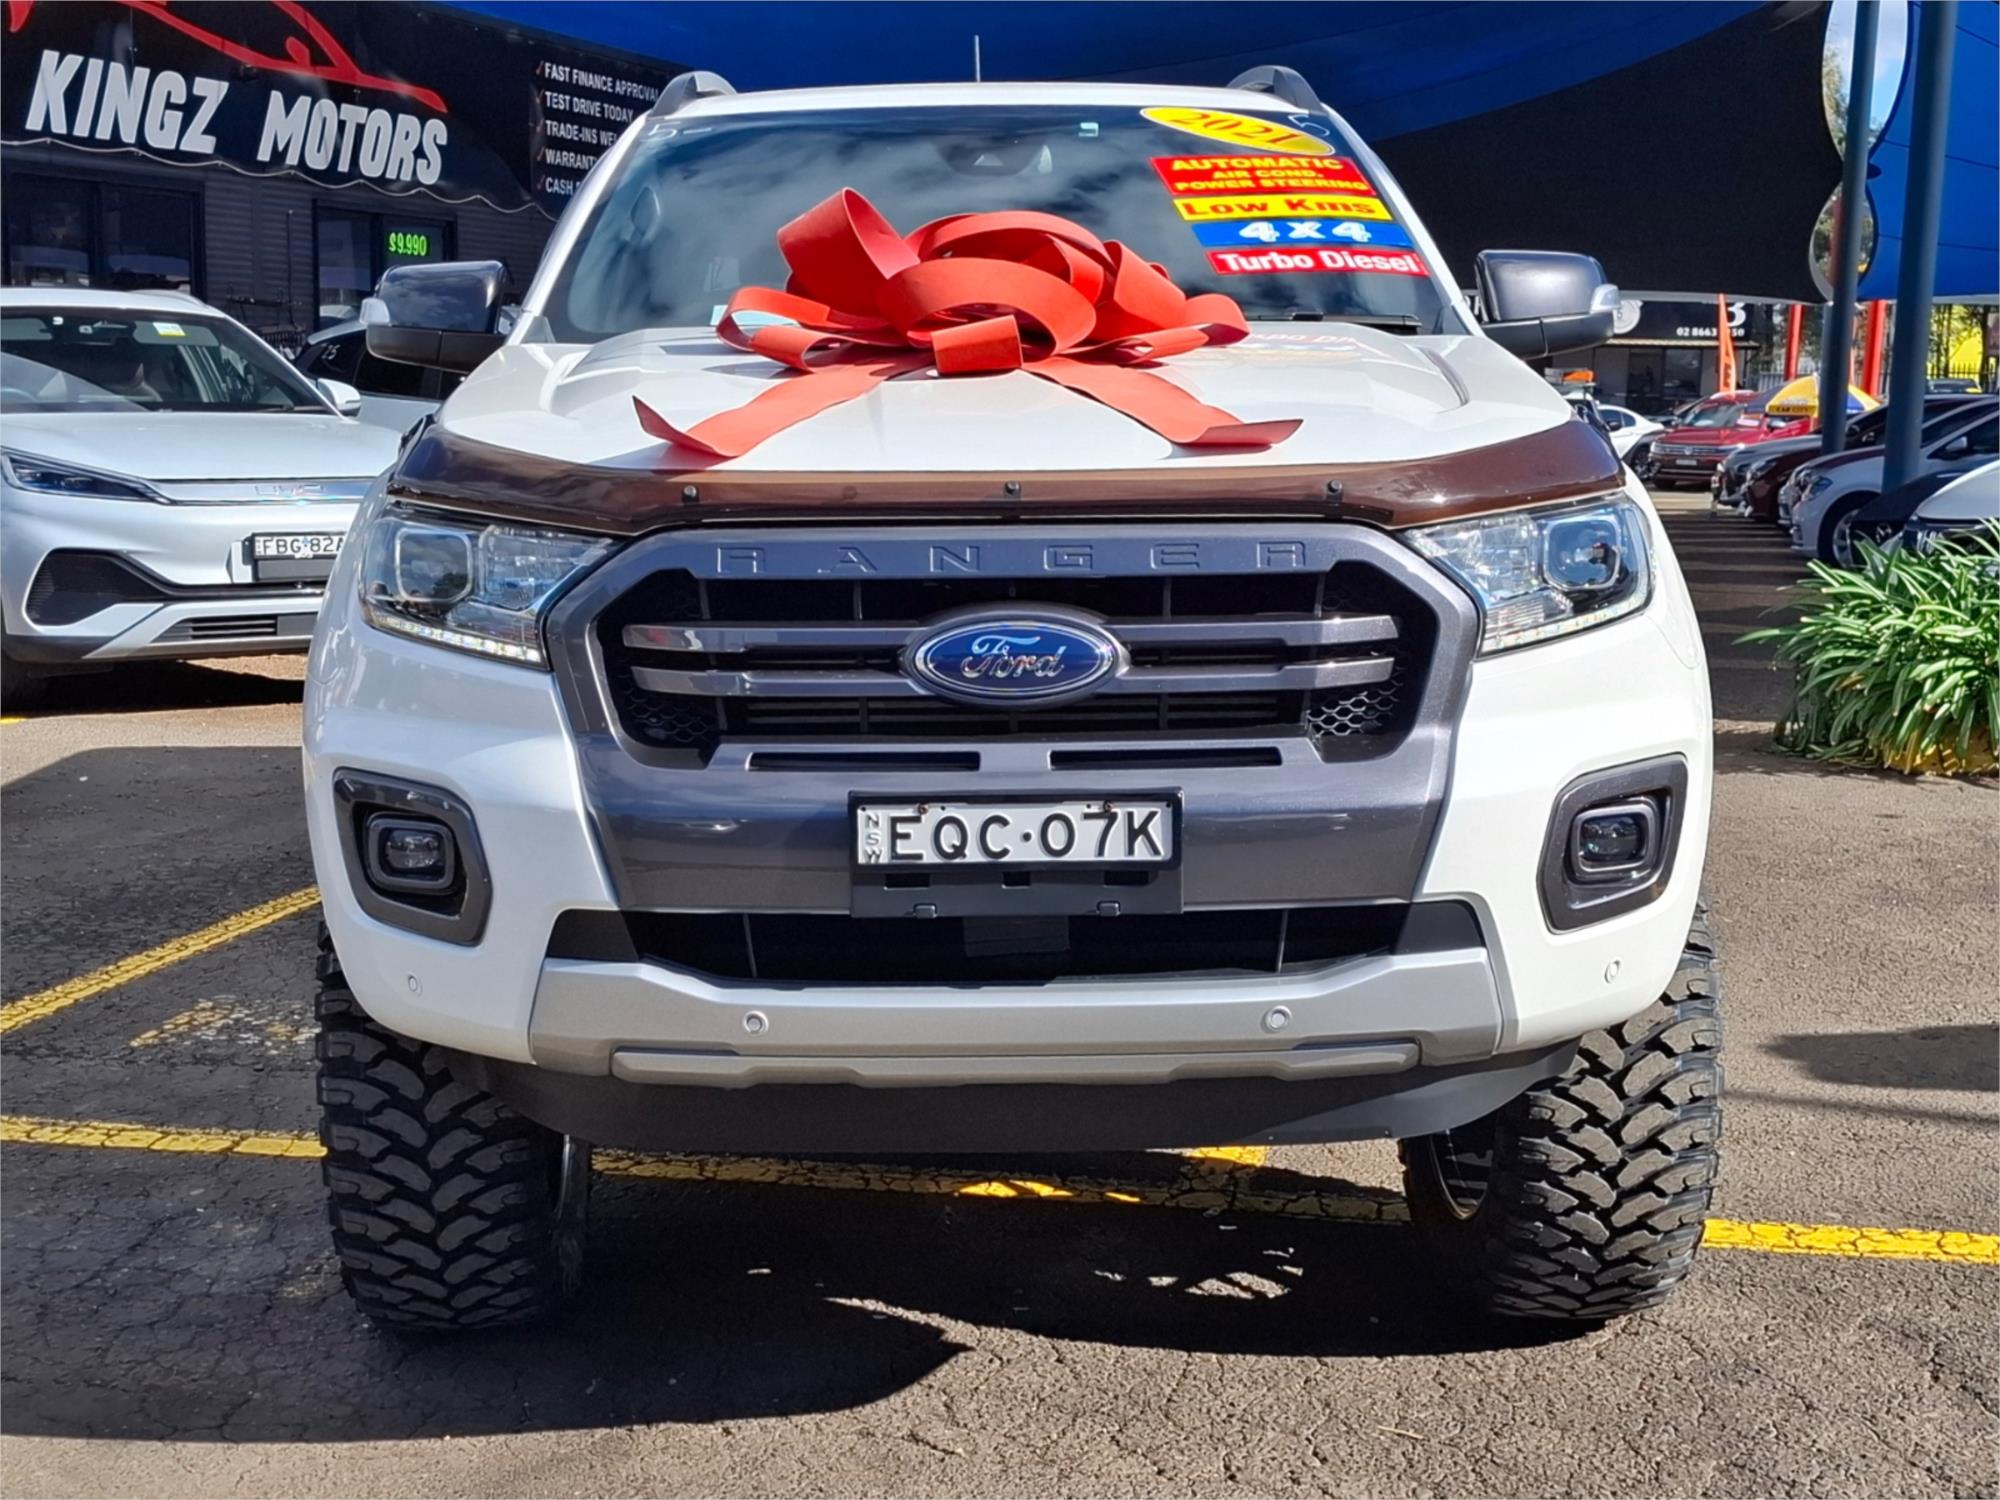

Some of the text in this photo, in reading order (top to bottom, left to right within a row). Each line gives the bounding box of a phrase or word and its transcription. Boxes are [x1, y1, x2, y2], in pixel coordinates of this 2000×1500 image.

[544, 62, 570, 82] FAST
[572, 69, 613, 93] FINANCE
[25, 49, 448, 185] KINGZ MOTORS
[545, 91, 634, 123] TEST DRIVE TODAY
[545, 120, 598, 145] TRADE-INS
[1168, 112, 1301, 144] 2021
[545, 148, 599, 170] WARRANT
[1172, 157, 1344, 171] AUTOMATIC
[545, 176, 574, 195] CASH
[1175, 178, 1370, 191] POWER STEERING
[1213, 169, 1324, 179] AIR COND.
[1182, 202, 1269, 216] Low
[1217, 250, 1421, 272] Turbo Diesel
[715, 540, 1307, 574] RANGER
[961, 635, 1066, 678] Ford
